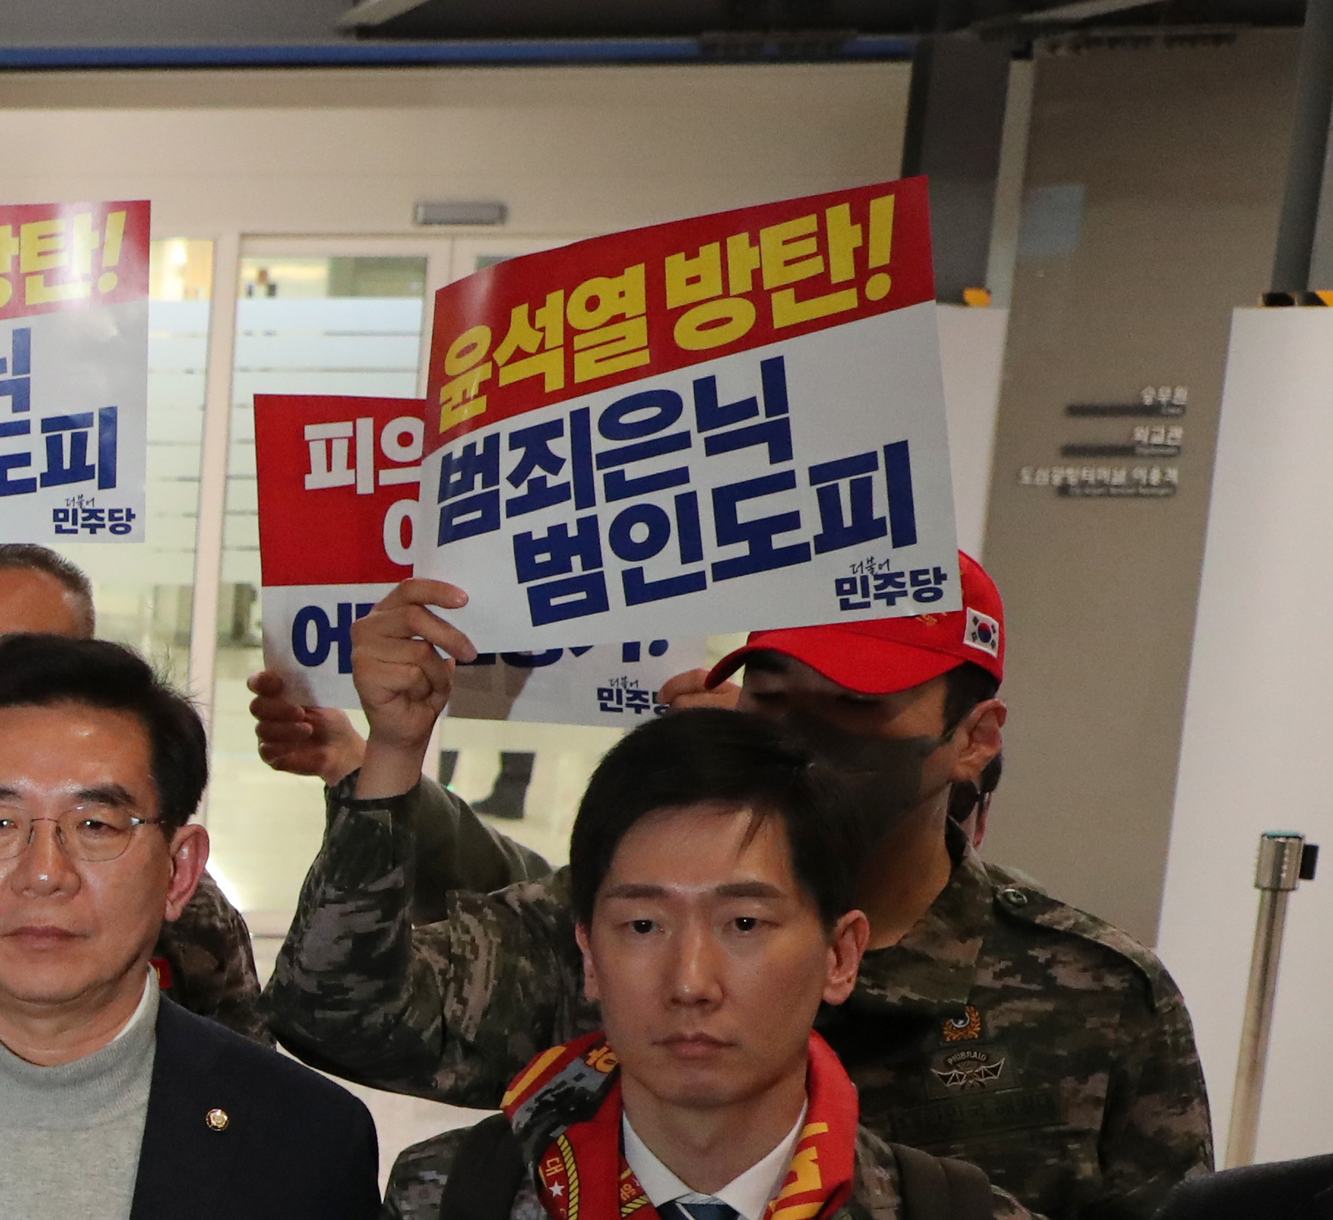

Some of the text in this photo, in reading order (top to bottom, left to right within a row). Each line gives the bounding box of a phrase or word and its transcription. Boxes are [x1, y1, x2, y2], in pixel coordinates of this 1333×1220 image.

[438, 195, 895, 433] 윤석열 방탄!
[53, 507, 136, 535] 민주당
[438, 355, 794, 547] 범죄은닉
[514, 440, 916, 627] 범인도피
[835, 566, 948, 611] 민주당
